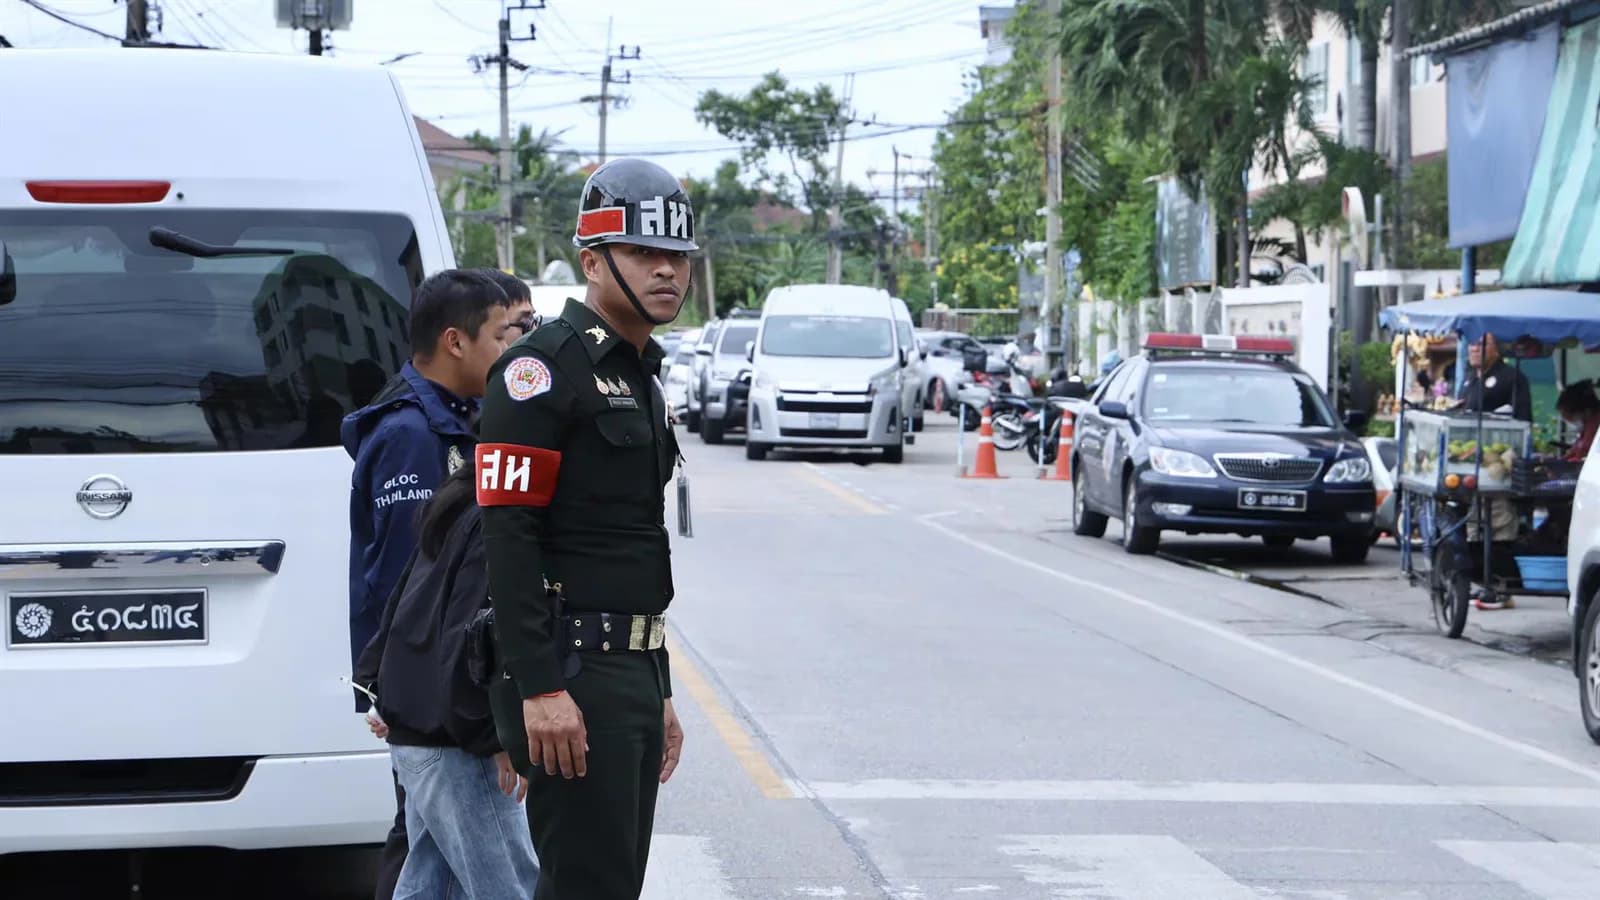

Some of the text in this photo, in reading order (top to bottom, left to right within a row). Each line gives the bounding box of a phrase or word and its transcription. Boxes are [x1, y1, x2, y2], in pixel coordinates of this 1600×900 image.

[640, 195, 688, 239] สห
[481, 449, 531, 492] สห
[383, 473, 419, 490] GLOC
[81, 492, 129, 501] NISSAN
[374, 488, 433, 509] THAILAND
